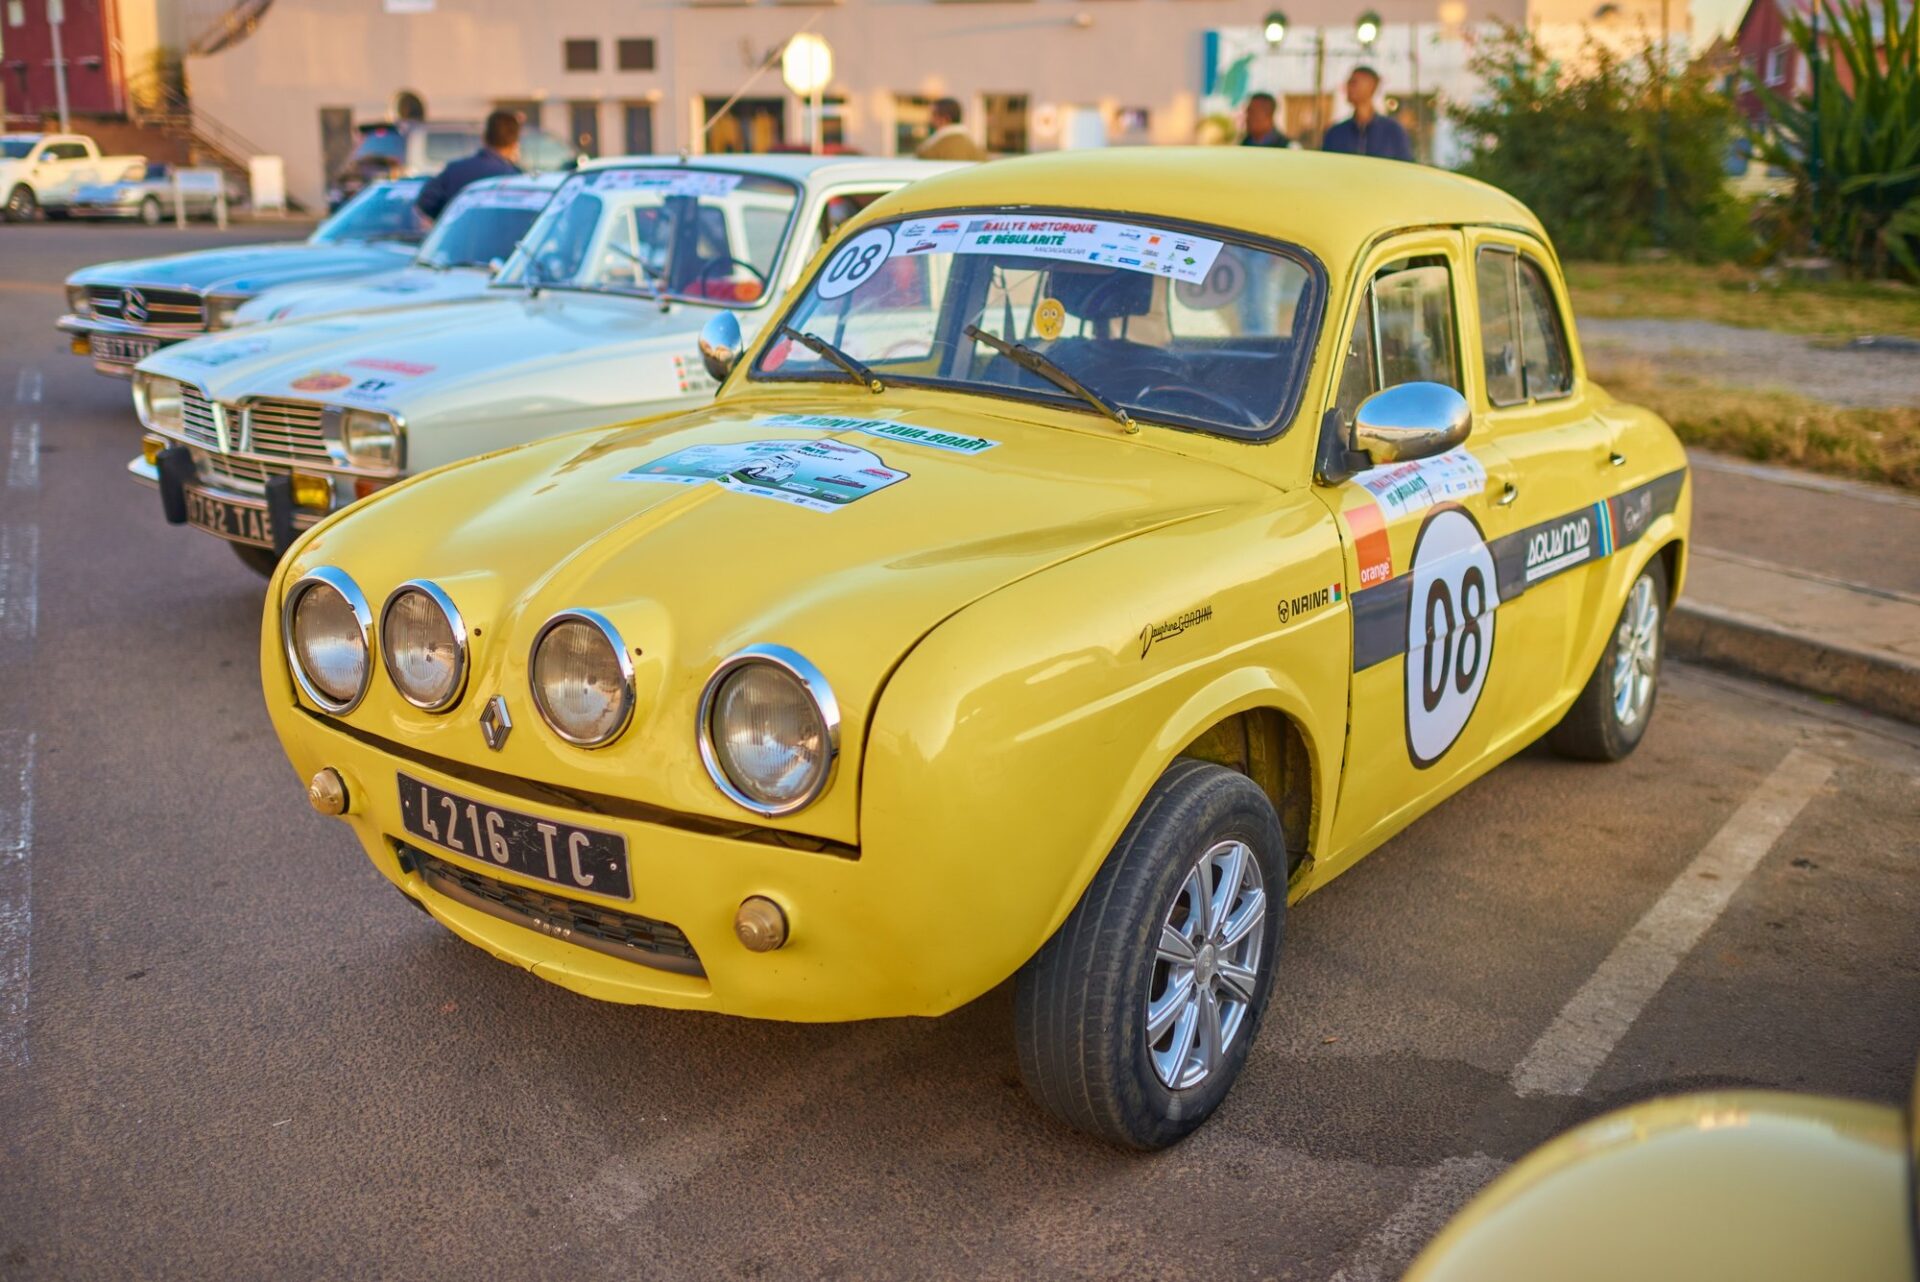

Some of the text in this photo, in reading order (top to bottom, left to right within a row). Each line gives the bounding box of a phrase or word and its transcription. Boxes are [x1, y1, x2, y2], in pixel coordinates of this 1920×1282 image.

[976, 234, 992, 245] DE
[982, 221, 1098, 234] RALLYE HISTORIQUE
[828, 244, 882, 283] 08
[876, 424, 994, 450] ZAVA-BOARY
[1527, 517, 1590, 567] AQUAMAD
[1360, 562, 1390, 583] orange
[1291, 588, 1329, 616] NAINA
[1139, 605, 1212, 660] Dauphine GORDINI
[1423, 565, 1486, 713] 08
[421, 786, 595, 887] 4216 TC
